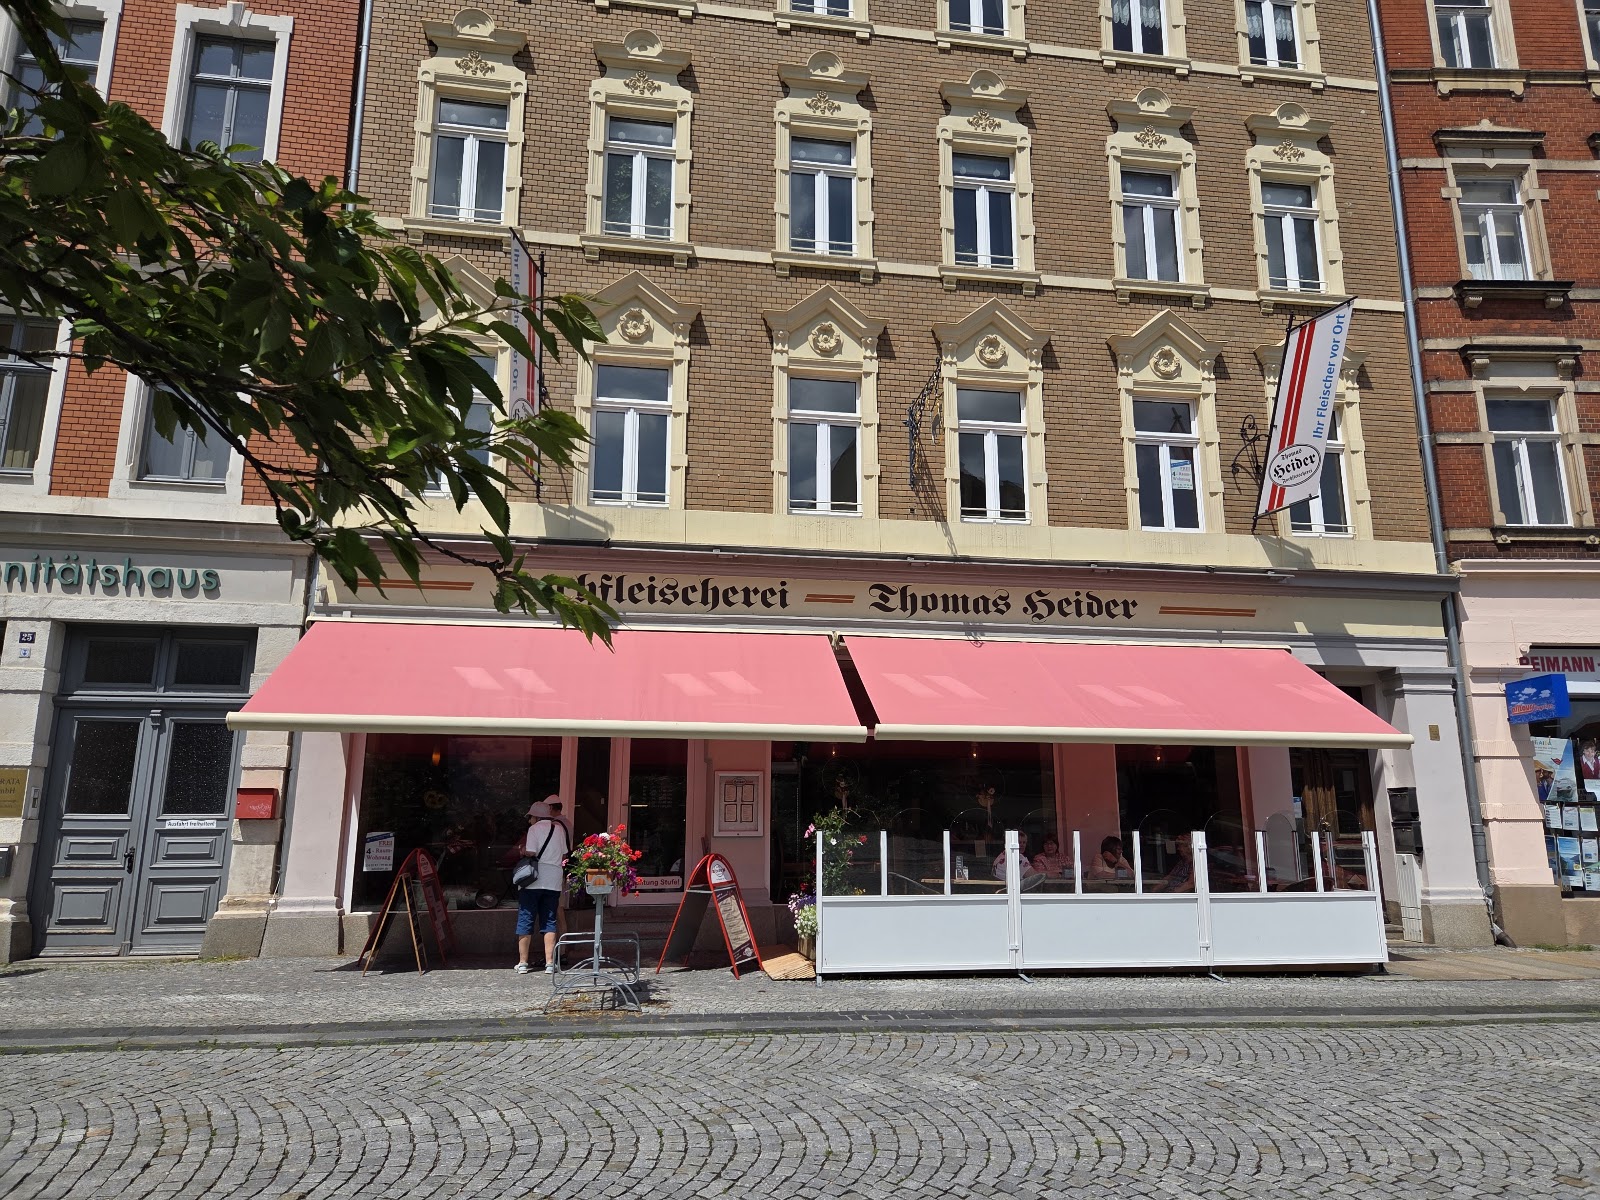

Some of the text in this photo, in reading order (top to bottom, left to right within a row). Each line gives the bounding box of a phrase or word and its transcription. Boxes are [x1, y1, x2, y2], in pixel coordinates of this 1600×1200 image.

[1312, 313, 1346, 439] Ihr Fleischer vor Ort
[1273, 453, 1316, 479] Heider
[556, 574, 790, 613] hfleischerei
[868, 582, 1138, 624] Thomas Heider
[21, 633, 33, 642] 25
[660, 878, 680, 886] Stufe!
